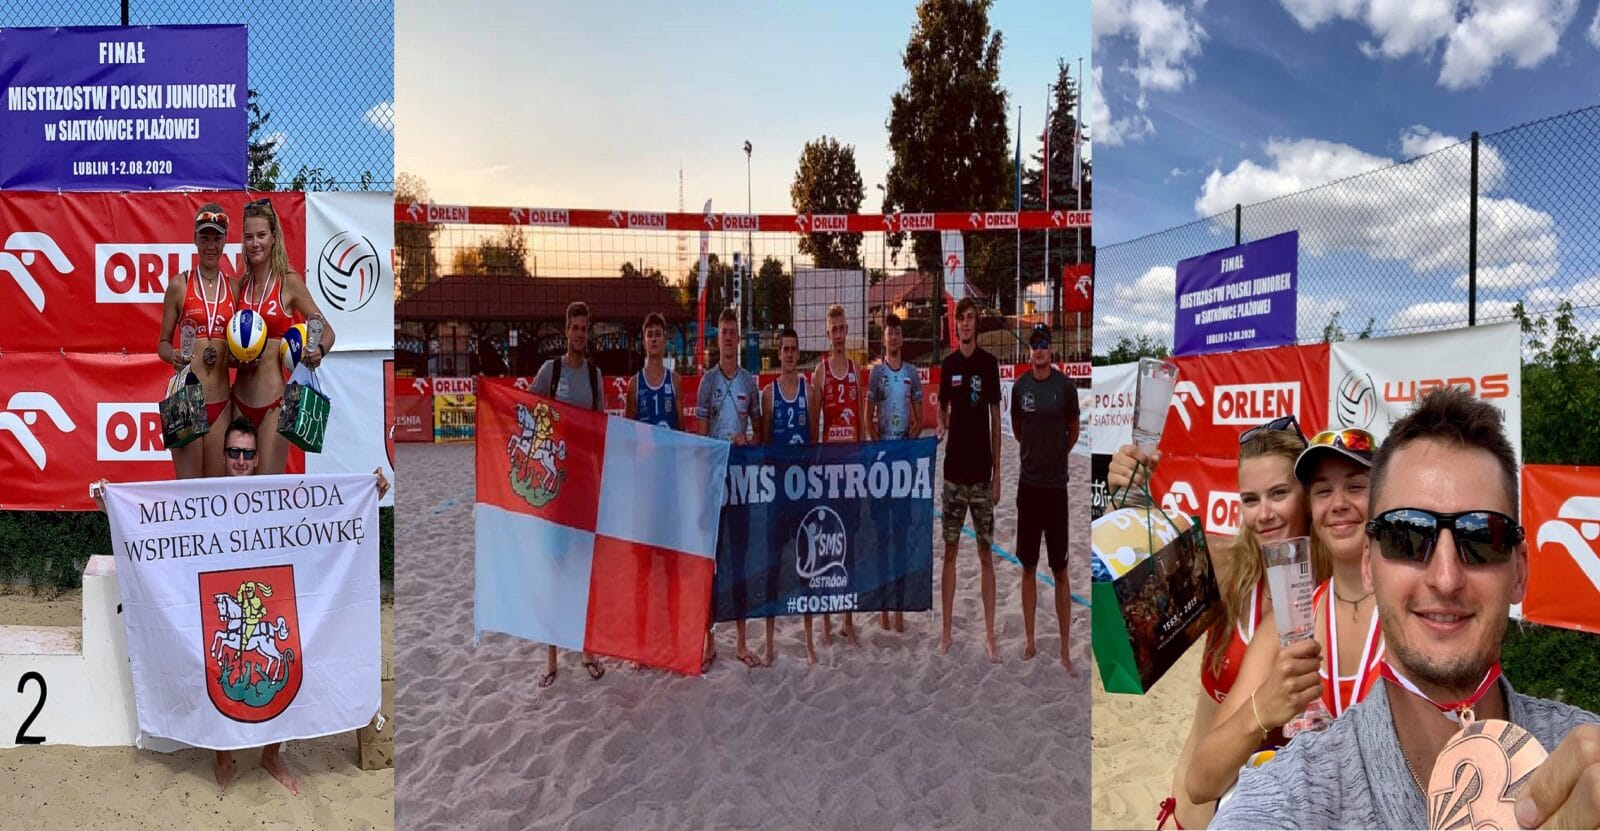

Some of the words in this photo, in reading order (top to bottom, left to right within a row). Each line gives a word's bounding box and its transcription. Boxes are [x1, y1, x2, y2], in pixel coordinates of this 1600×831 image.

[99, 41, 146, 64] FINAŁ
[8, 85, 108, 111] MISTRZOSTW
[111, 84, 162, 110] POLSKI
[165, 84, 237, 109] JUNIOREK
[58, 116, 134, 141] SIATKÓWCE
[136, 115, 200, 140] PLAŻOWEJ
[73, 161, 108, 176] LUBLIN
[111, 160, 172, 175] 1-2.08.2020
[429, 207, 466, 220] ORLEN
[531, 211, 567, 223] ORLEN
[630, 214, 664, 226] ORLEN
[724, 217, 757, 228] ORLEN
[814, 216, 847, 229] ORLEN
[902, 215, 933, 228] ORLEN
[987, 214, 1017, 226] ORLEN
[1221, 254, 1244, 273] FINAŁ
[1179, 285, 1226, 309] MISTRZOSTW
[1226, 280, 1252, 300] POLSKI
[1252, 272, 1291, 295] JUNIOREK
[267, 300, 277, 316] 2
[435, 380, 472, 392] ORLEN
[838, 384, 845, 403] 2
[653, 394, 659, 416] 1
[1217, 388, 1294, 420] ORLEN
[394, 414, 422, 425] EŚNIA
[787, 407, 795, 428] 2
[784, 451, 933, 501] OSTRÓDA
[139, 493, 228, 524] MIASTO
[234, 481, 345, 514] OSTRÓDA
[123, 532, 224, 562] WSPIERA
[230, 517, 365, 553] SIATKÓWKĘ
[818, 532, 843, 556] SMS
[809, 575, 847, 588] OSTRÓDA
[786, 592, 858, 613] #GOSMS!
[14, 671, 48, 745] 2
